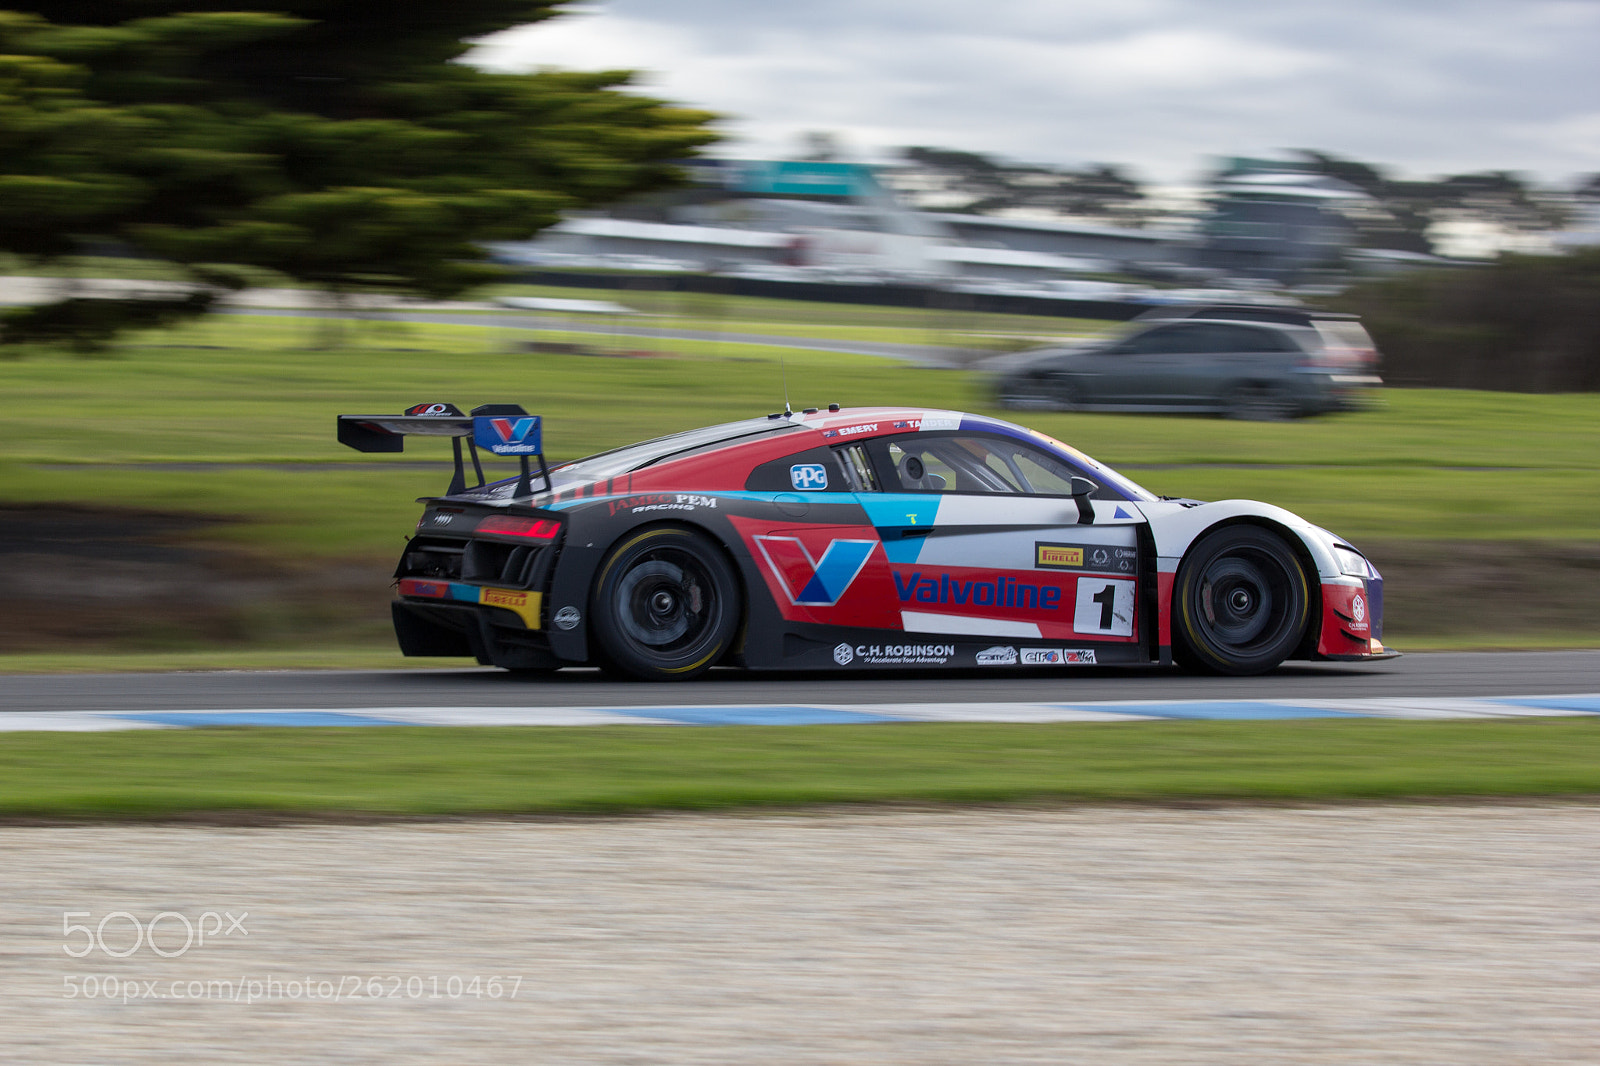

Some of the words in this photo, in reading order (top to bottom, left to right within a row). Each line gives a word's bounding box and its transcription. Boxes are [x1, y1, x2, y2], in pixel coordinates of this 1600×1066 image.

[839, 423, 878, 436] EMERY
[491, 443, 536, 453] Valvoline
[793, 467, 825, 488] PPG
[607, 494, 671, 517] JAMEC
[675, 494, 718, 509] PEM
[632, 503, 695, 514] RACING
[1042, 550, 1080, 563] PIRELLI
[484, 588, 528, 607] PIRELLI
[892, 571, 1062, 610] Valvoline
[1092, 584, 1116, 630] 1
[855, 645, 883, 656] C.H.
[885, 644, 955, 656] ROBINSON
